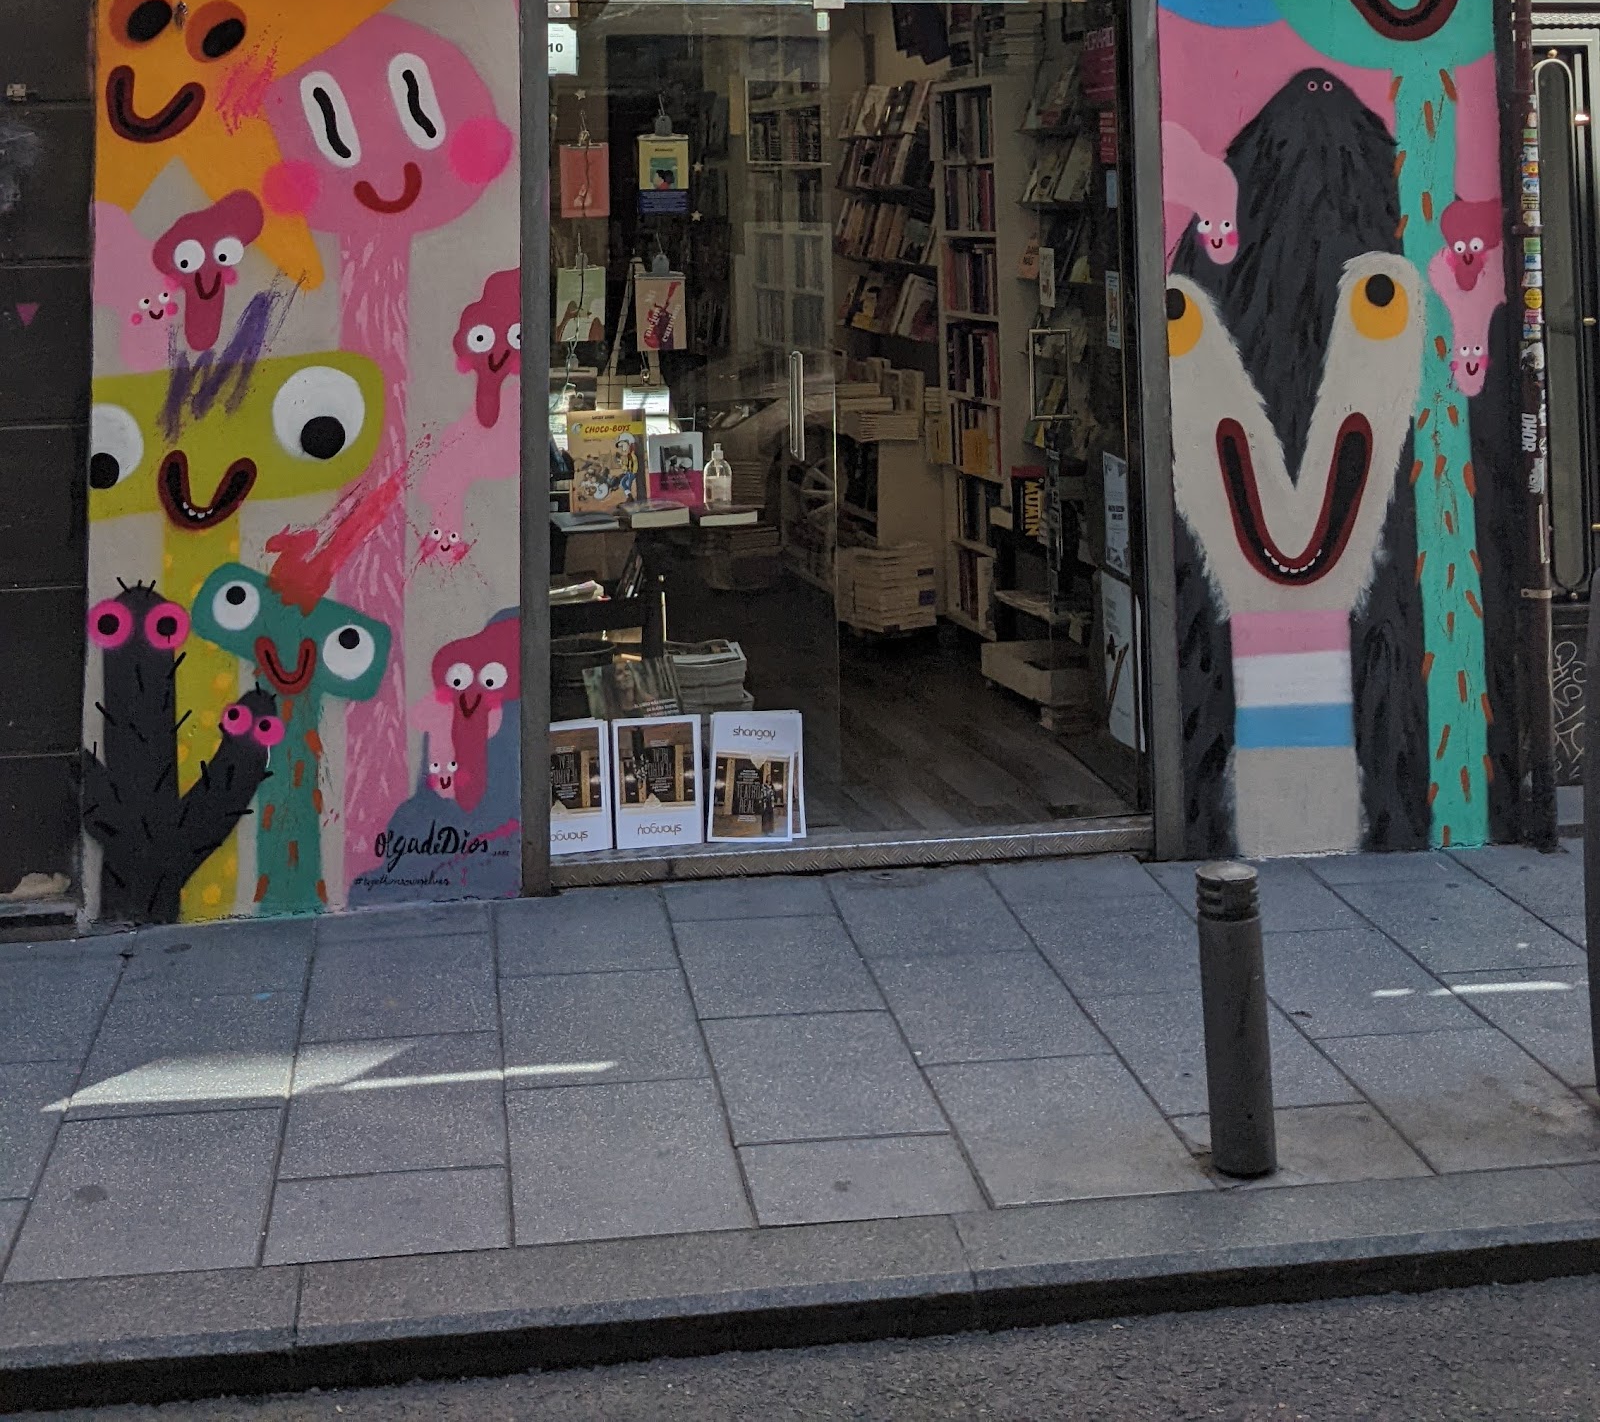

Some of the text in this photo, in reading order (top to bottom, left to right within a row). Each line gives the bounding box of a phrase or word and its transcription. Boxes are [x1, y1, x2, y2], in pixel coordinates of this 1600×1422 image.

[584, 423, 631, 435] CHOCO-BOYS
[732, 725, 777, 741] shangay
[550, 829, 589, 842] shanga
[637, 823, 683, 837] shangay
